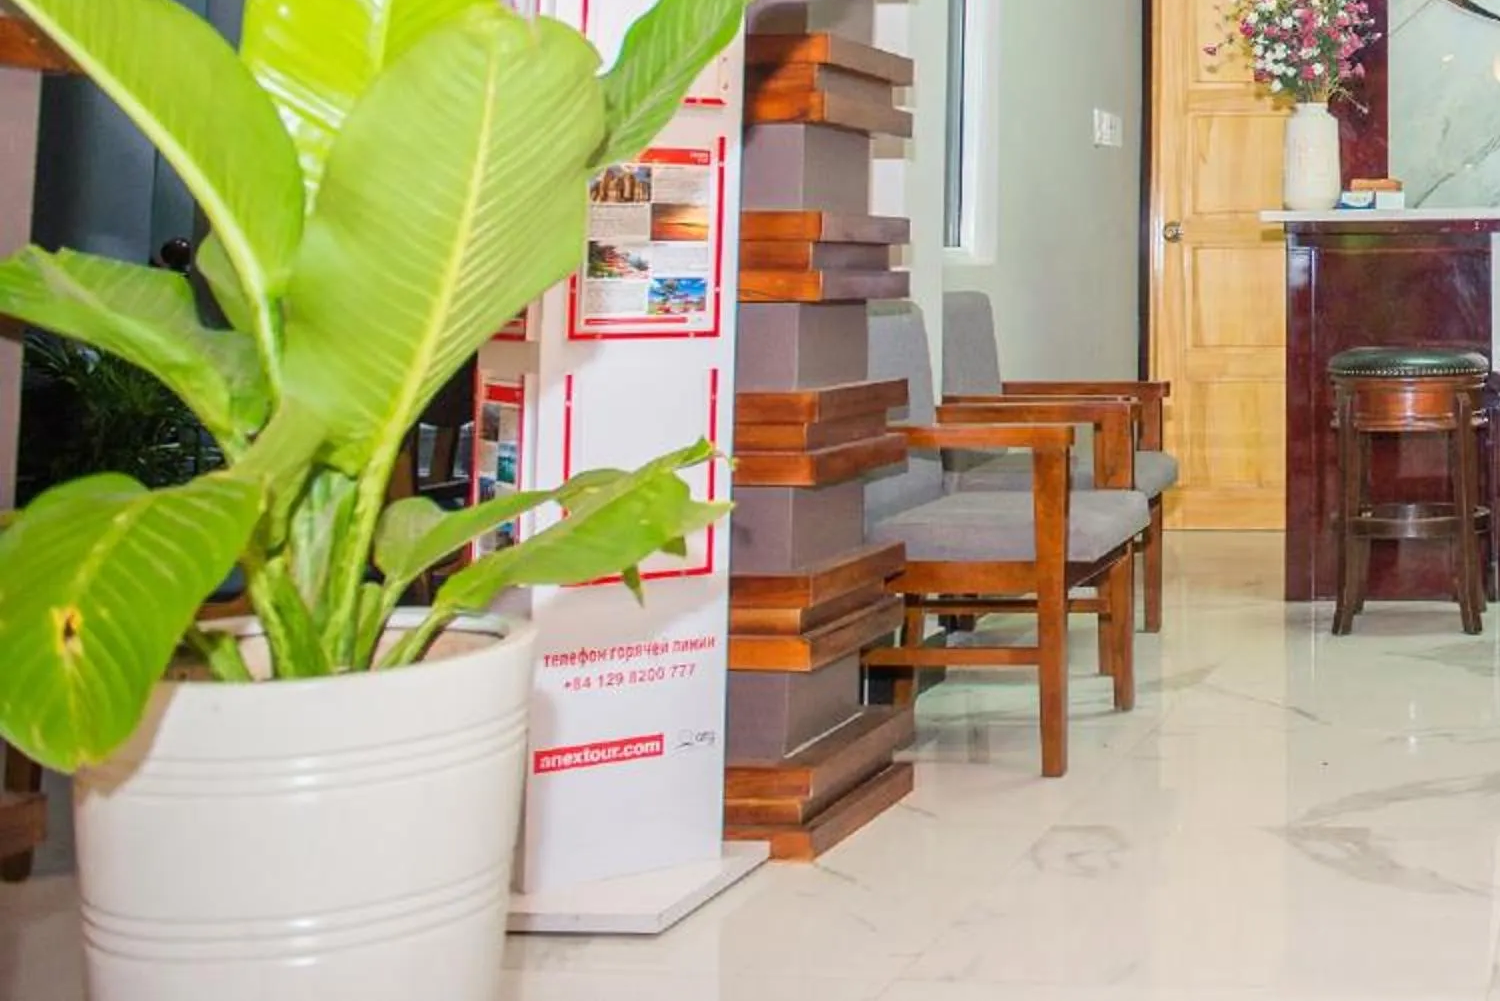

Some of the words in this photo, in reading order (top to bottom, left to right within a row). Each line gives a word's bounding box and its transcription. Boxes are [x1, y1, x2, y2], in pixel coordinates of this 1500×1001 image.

[599, 672, 624, 688] 129
[670, 663, 696, 679] 777
[540, 739, 660, 769] anextour.com
